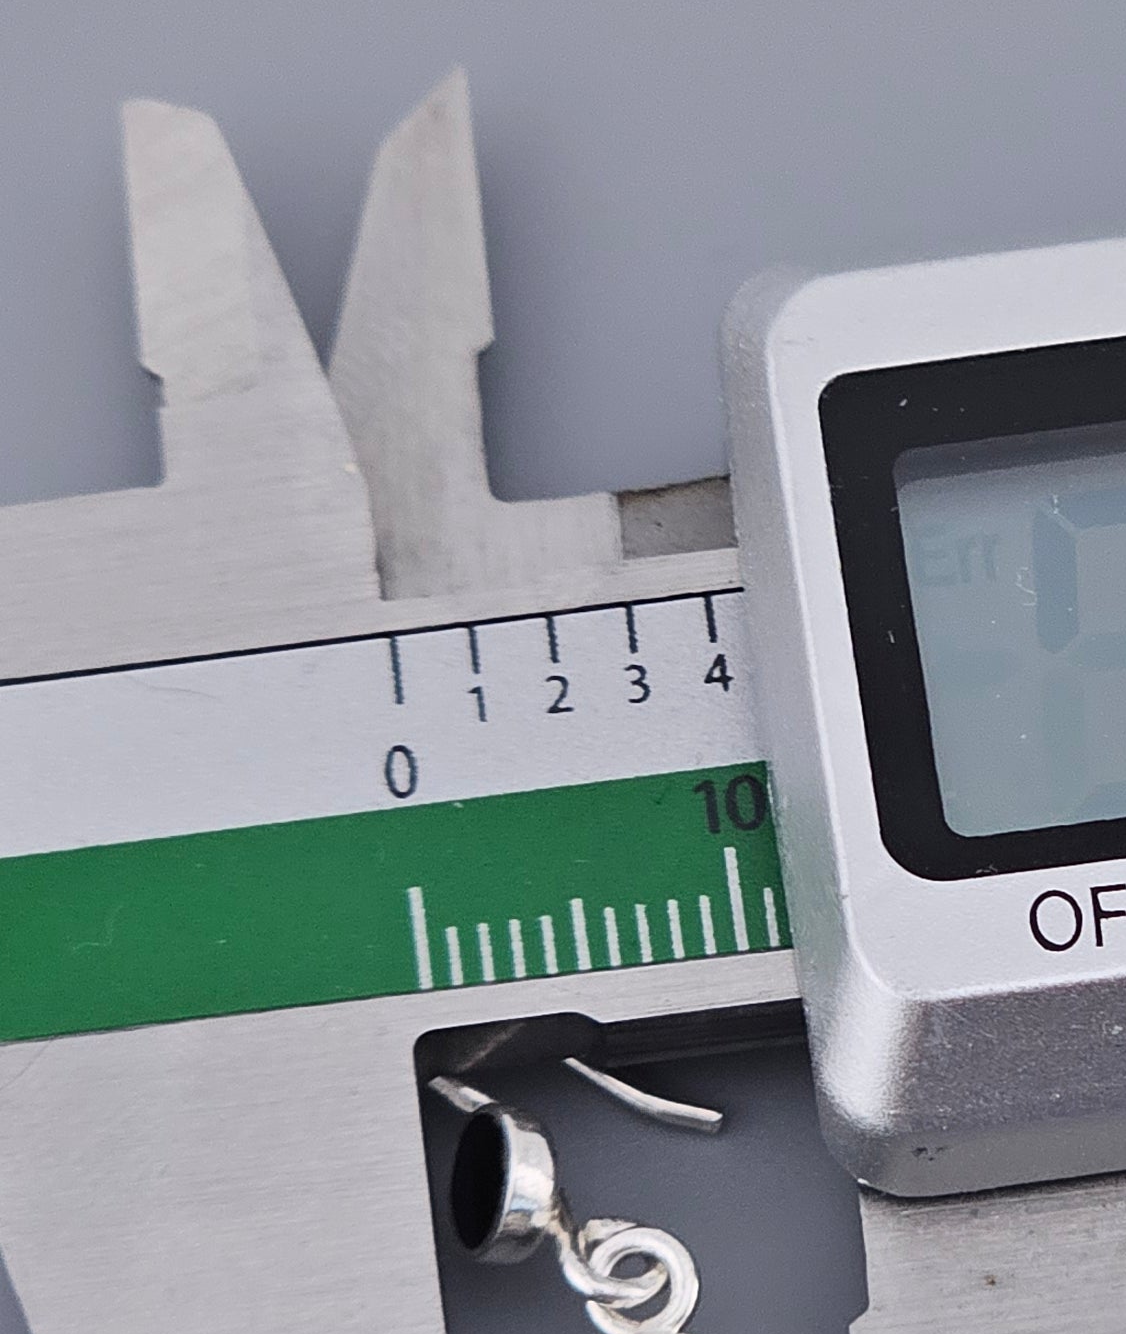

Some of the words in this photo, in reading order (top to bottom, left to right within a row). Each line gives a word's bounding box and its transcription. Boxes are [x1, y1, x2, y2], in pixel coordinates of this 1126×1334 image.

[467, 685, 488, 723] 1
[544, 675, 574, 714] 2
[623, 664, 652, 704] 3
[704, 653, 734, 692] 4
[384, 744, 418, 799] 0
[692, 773, 768, 834] 10
